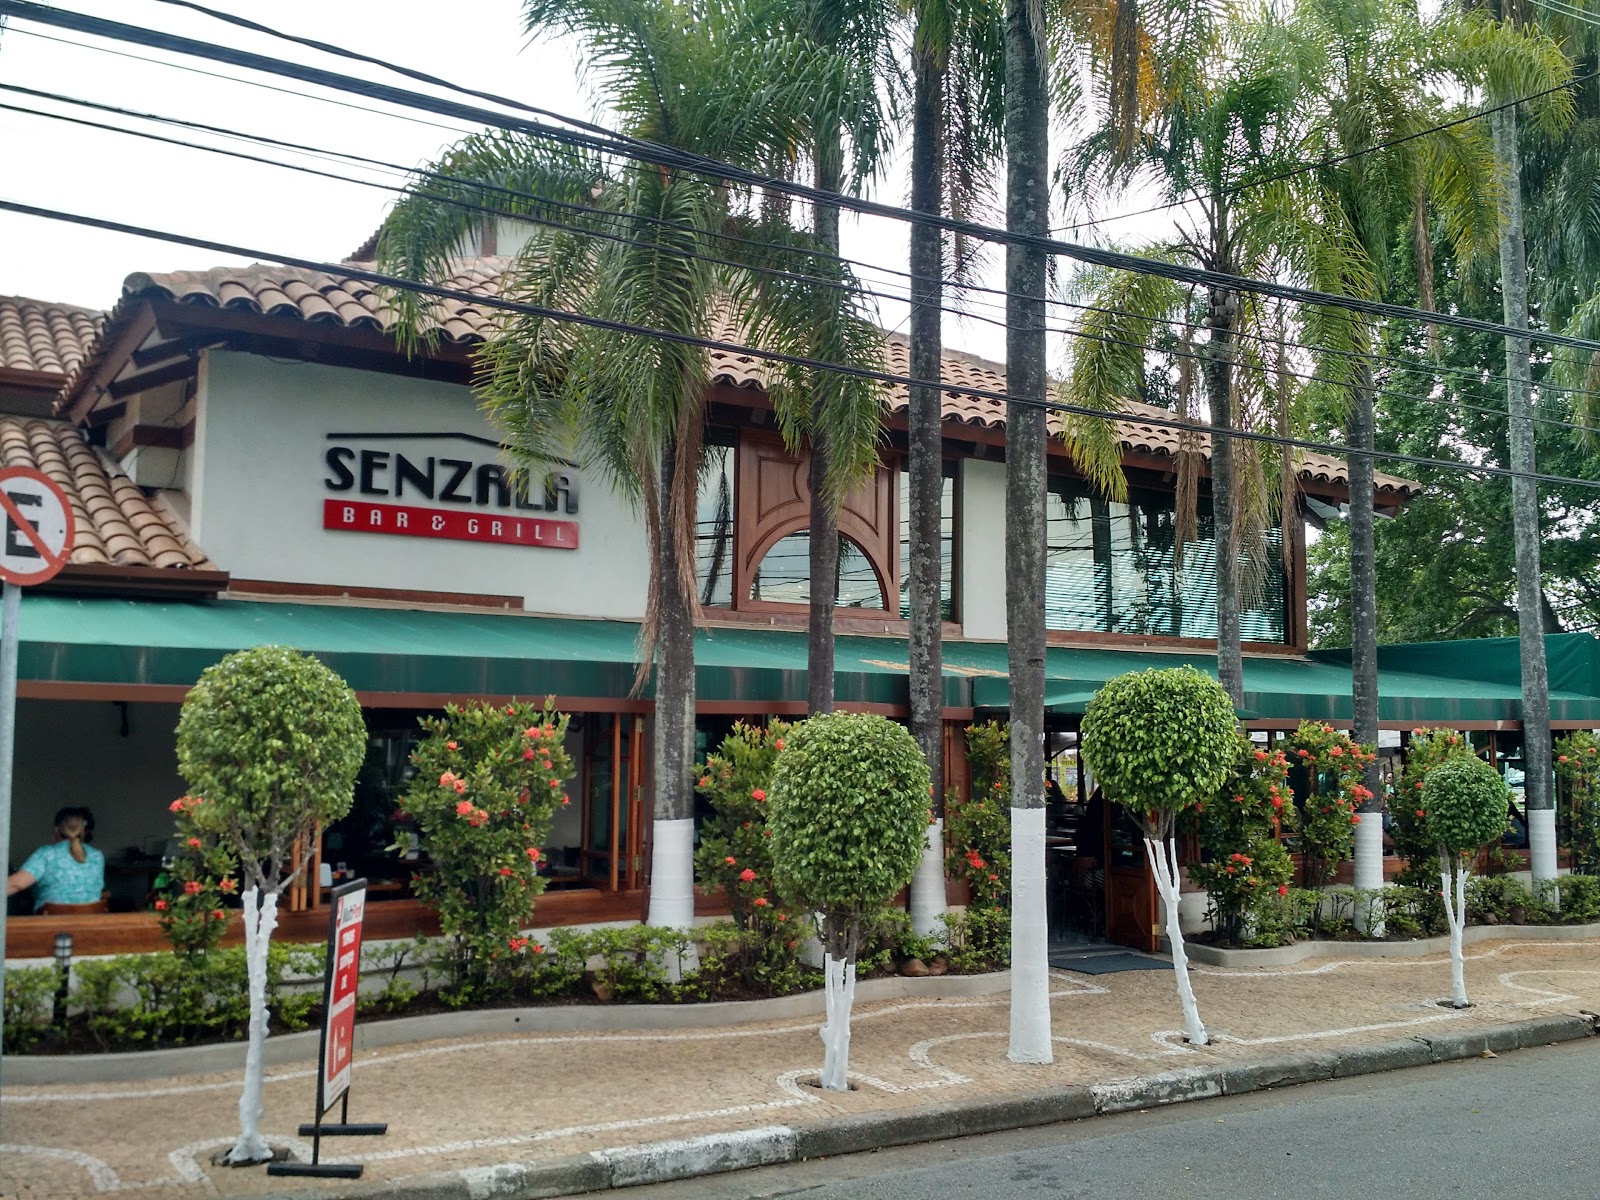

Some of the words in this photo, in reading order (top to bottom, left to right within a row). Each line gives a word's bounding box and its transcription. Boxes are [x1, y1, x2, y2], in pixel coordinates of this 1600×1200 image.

[324, 446, 579, 514] SENZALA
[6, 491, 43, 559] E
[343, 507, 409, 528] BAR
[431, 515, 446, 531] &
[467, 519, 565, 541] GRILL
